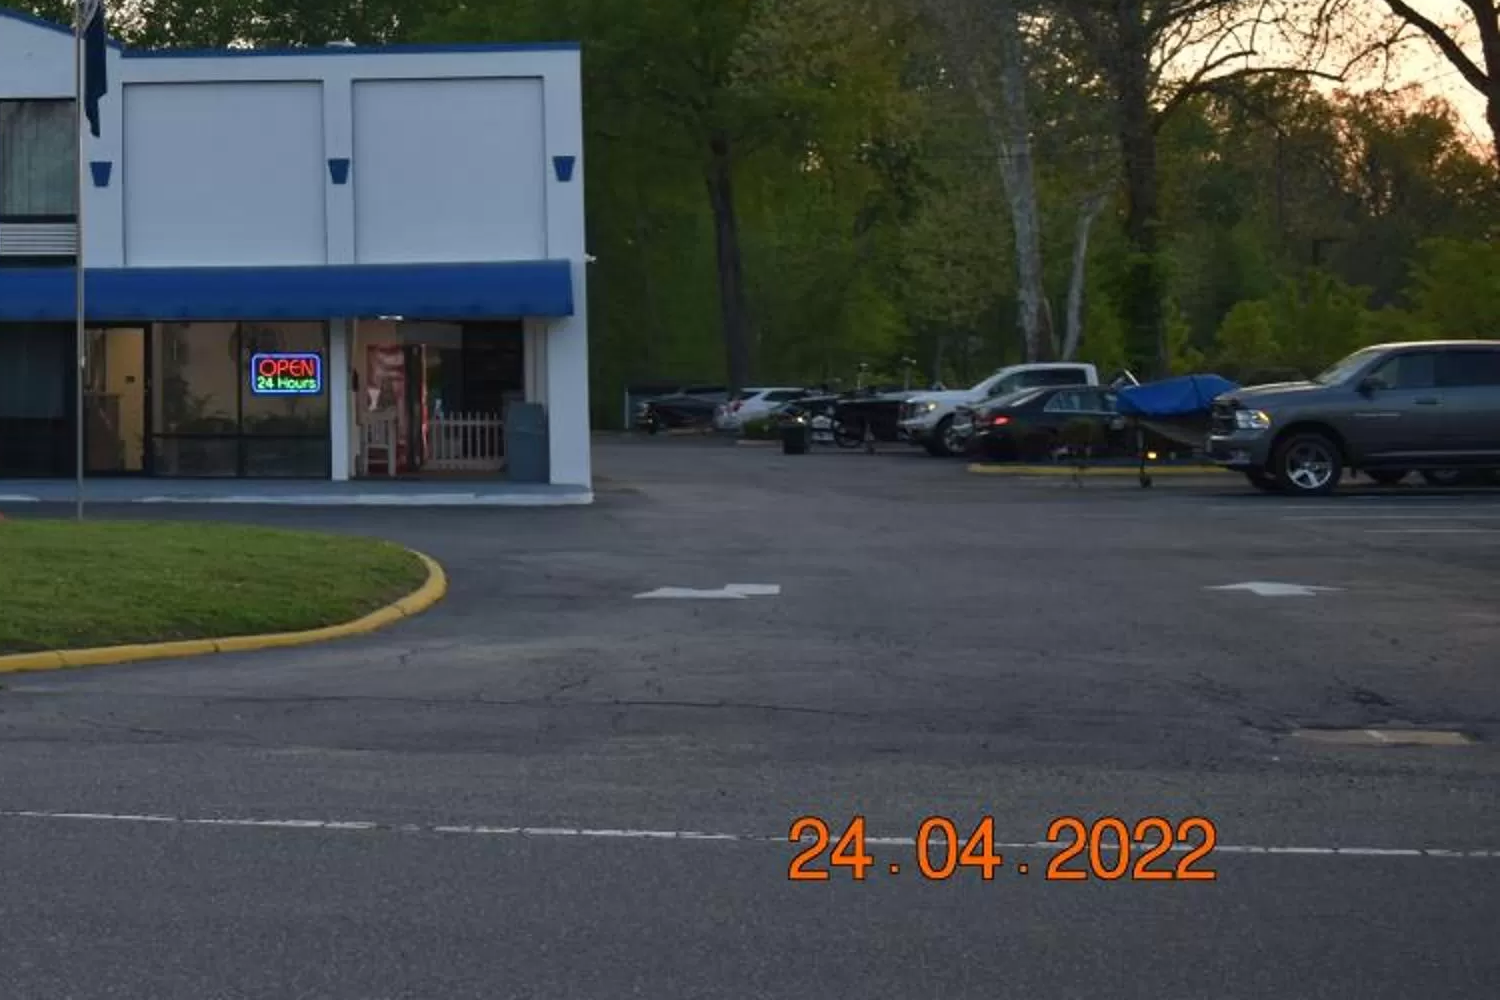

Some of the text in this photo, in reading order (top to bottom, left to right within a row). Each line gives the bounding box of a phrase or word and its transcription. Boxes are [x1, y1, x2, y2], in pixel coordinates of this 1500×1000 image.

[259, 358, 315, 377] OPEN
[257, 375, 318, 390] 24 Hours
